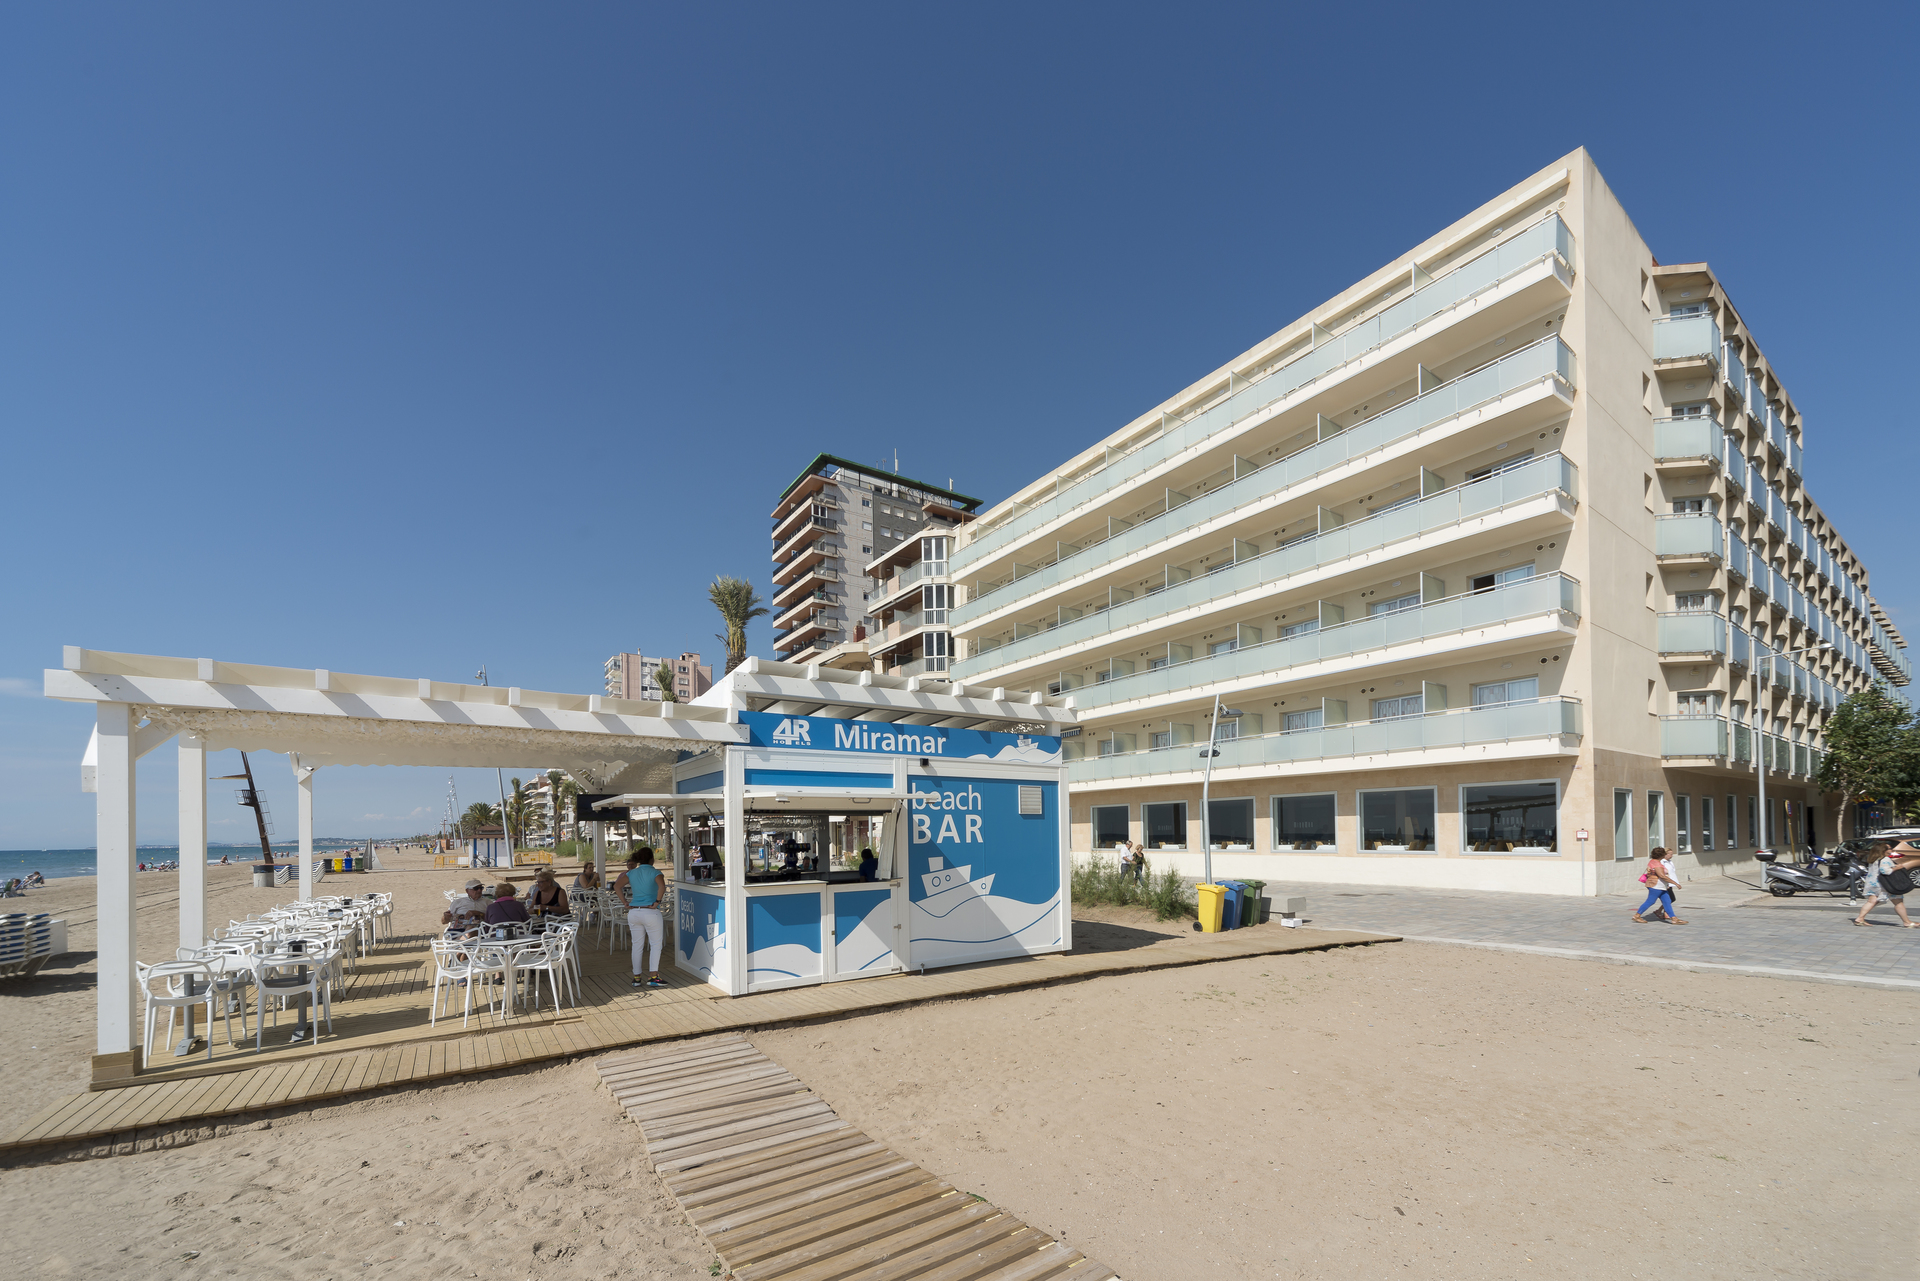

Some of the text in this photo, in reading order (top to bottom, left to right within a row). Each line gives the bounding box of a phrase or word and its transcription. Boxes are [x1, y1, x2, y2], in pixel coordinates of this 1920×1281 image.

[834, 723, 946, 754] Miramar
[912, 782, 982, 811] beach
[912, 814, 984, 844] BAR
[680, 895, 695, 913] beach
[680, 912, 695, 934] BAR
